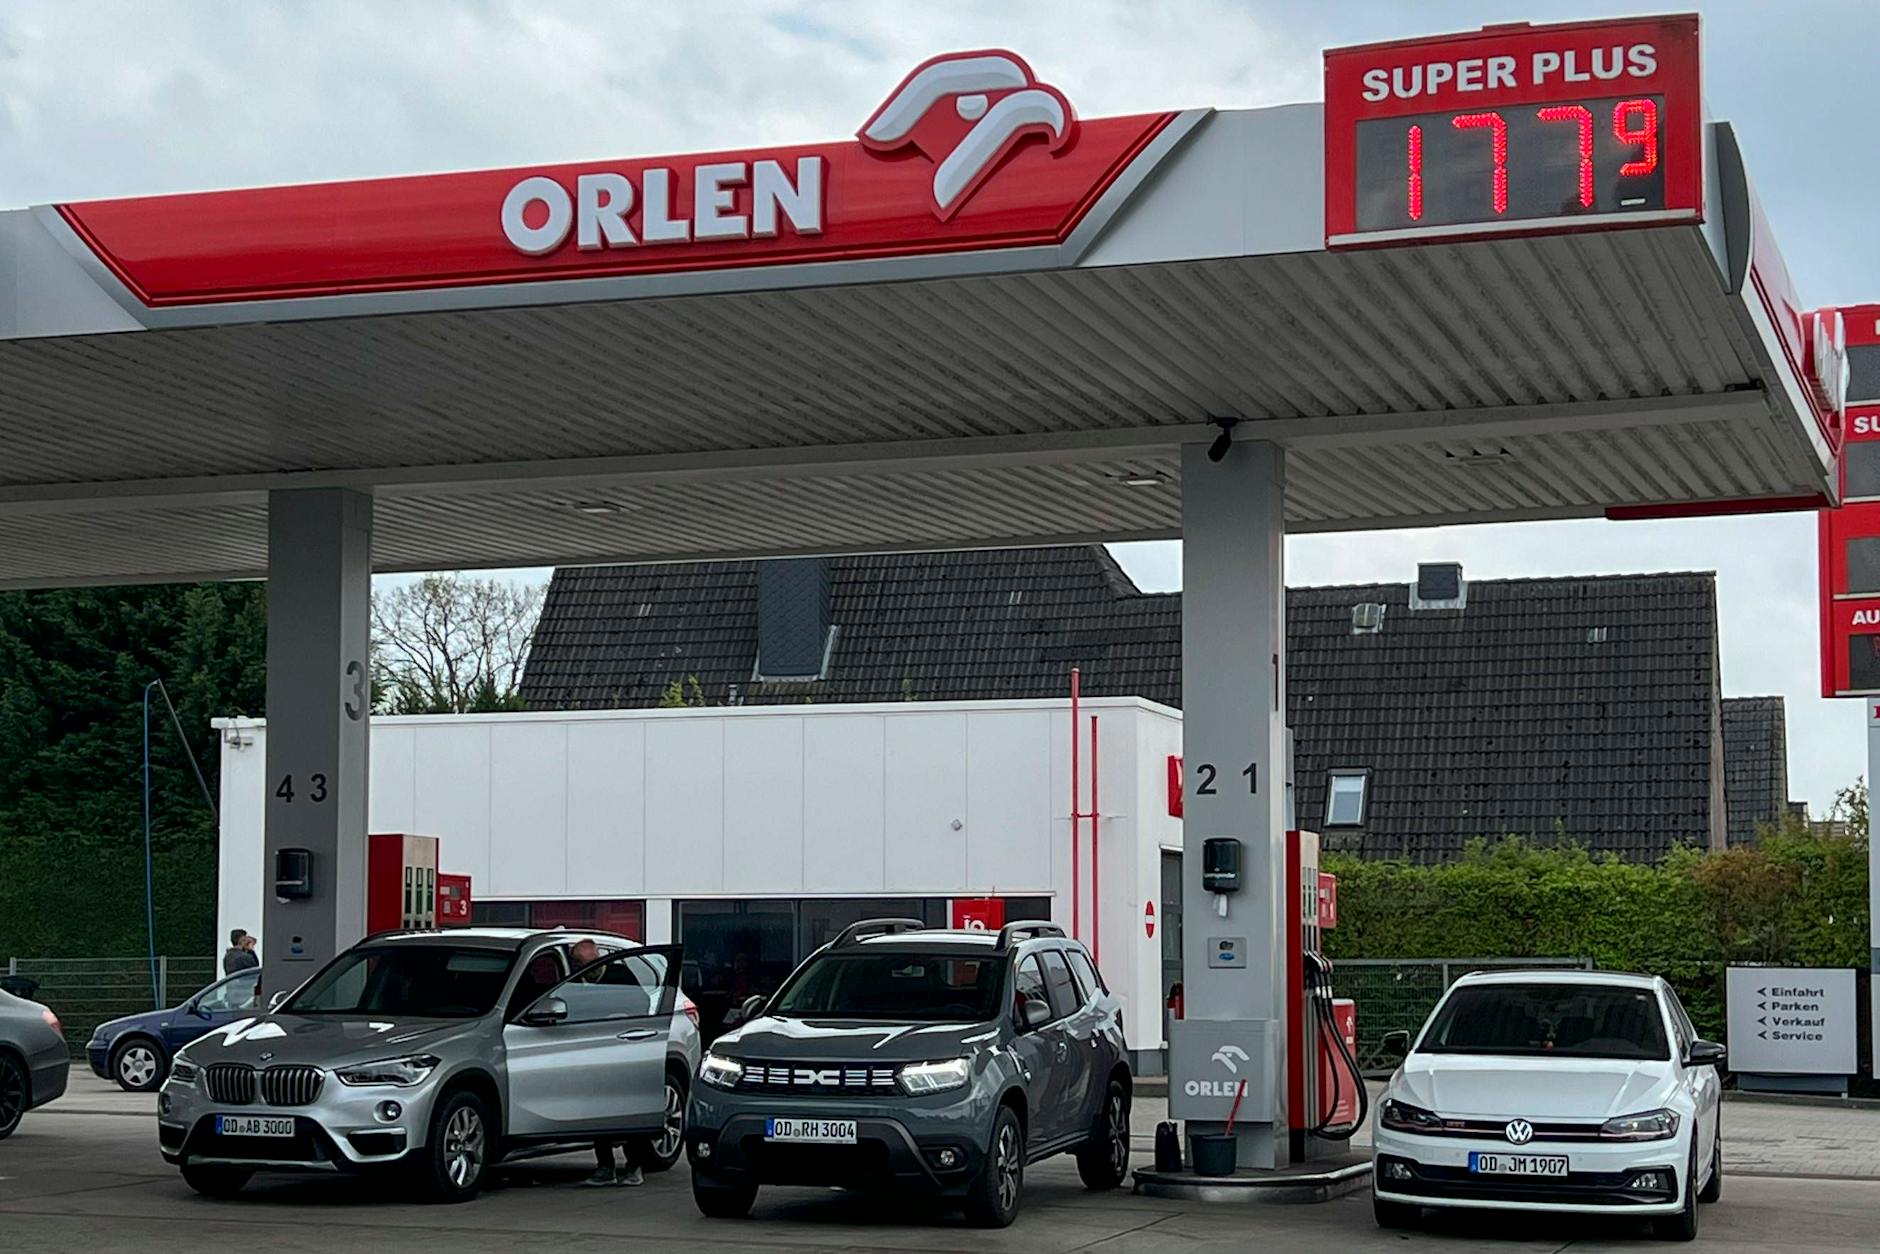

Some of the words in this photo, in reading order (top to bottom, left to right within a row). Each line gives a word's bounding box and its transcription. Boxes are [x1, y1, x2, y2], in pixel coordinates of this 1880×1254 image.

[1362, 56, 1517, 101] SUPER
[1532, 43, 1657, 85] PLUS
[501, 156, 822, 256] ORLEN
[344, 660, 365, 721] 3
[1196, 763, 1217, 795] 2
[1242, 762, 1257, 794] 1
[275, 774, 295, 803] 4
[310, 773, 327, 803] 3
[460, 899, 467, 916] 3
[1771, 987, 1824, 997] Einfahrt
[1772, 1001, 1819, 1011] Parken
[1772, 1016, 1825, 1027] Verkauf
[1772, 1030, 1823, 1041] Service
[1184, 1080, 1248, 1097] ORLEN
[223, 1118, 238, 1132] OD
[246, 1119, 260, 1134] AB
[263, 1120, 292, 1135] 3000
[775, 1121, 792, 1136] OD
[801, 1122, 818, 1137] RH
[822, 1122, 854, 1138] 3004
[1480, 1155, 1497, 1171] OD
[1508, 1156, 1527, 1172] JM
[1530, 1157, 1565, 1174] 1907
